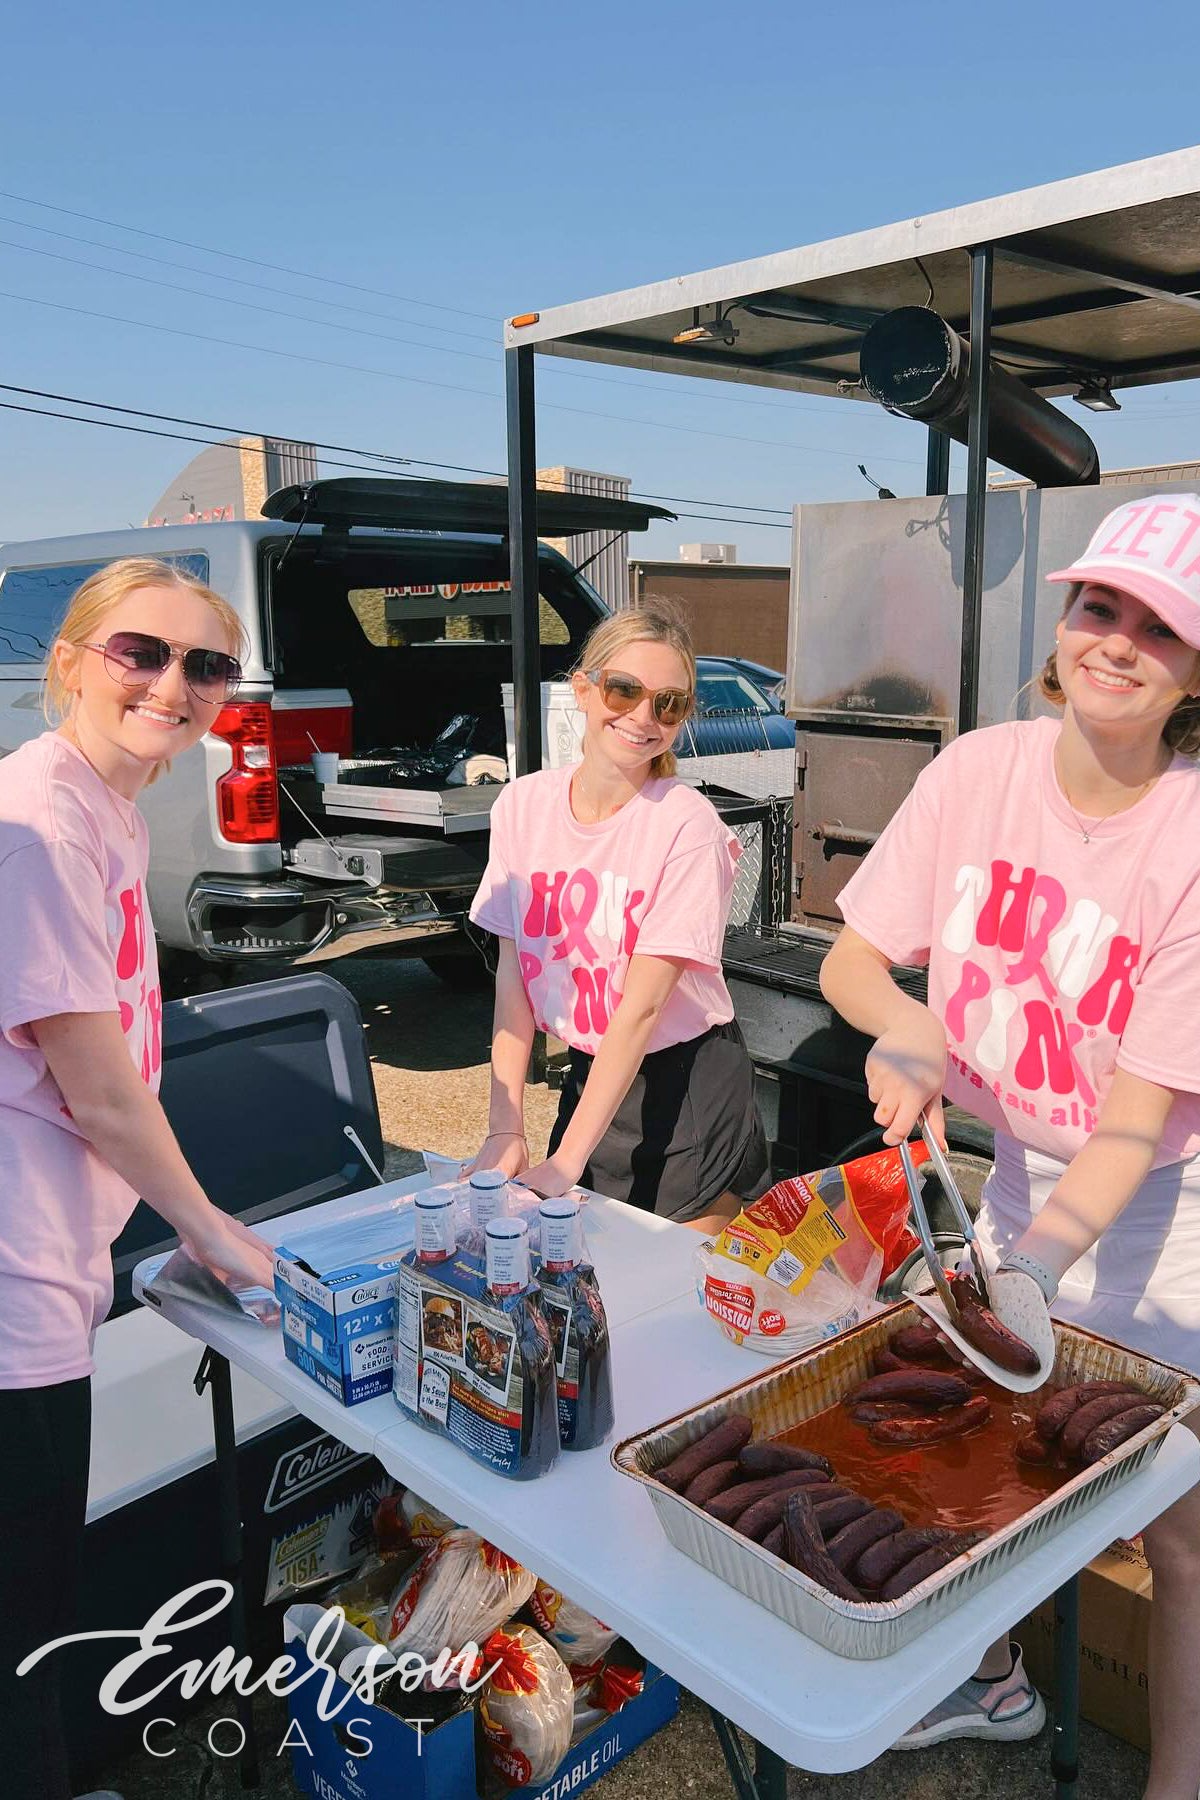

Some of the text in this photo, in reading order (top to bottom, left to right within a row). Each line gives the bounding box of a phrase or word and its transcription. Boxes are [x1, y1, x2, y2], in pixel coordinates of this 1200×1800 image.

[1049, 1102, 1098, 1133] alp
[343, 1314, 369, 1337] 12"
[362, 1354, 394, 1371] SERVICE
[367, 1346, 388, 1359] FOOD
[285, 1442, 351, 1487] Colem
[602, 1733, 623, 1763] OIL
